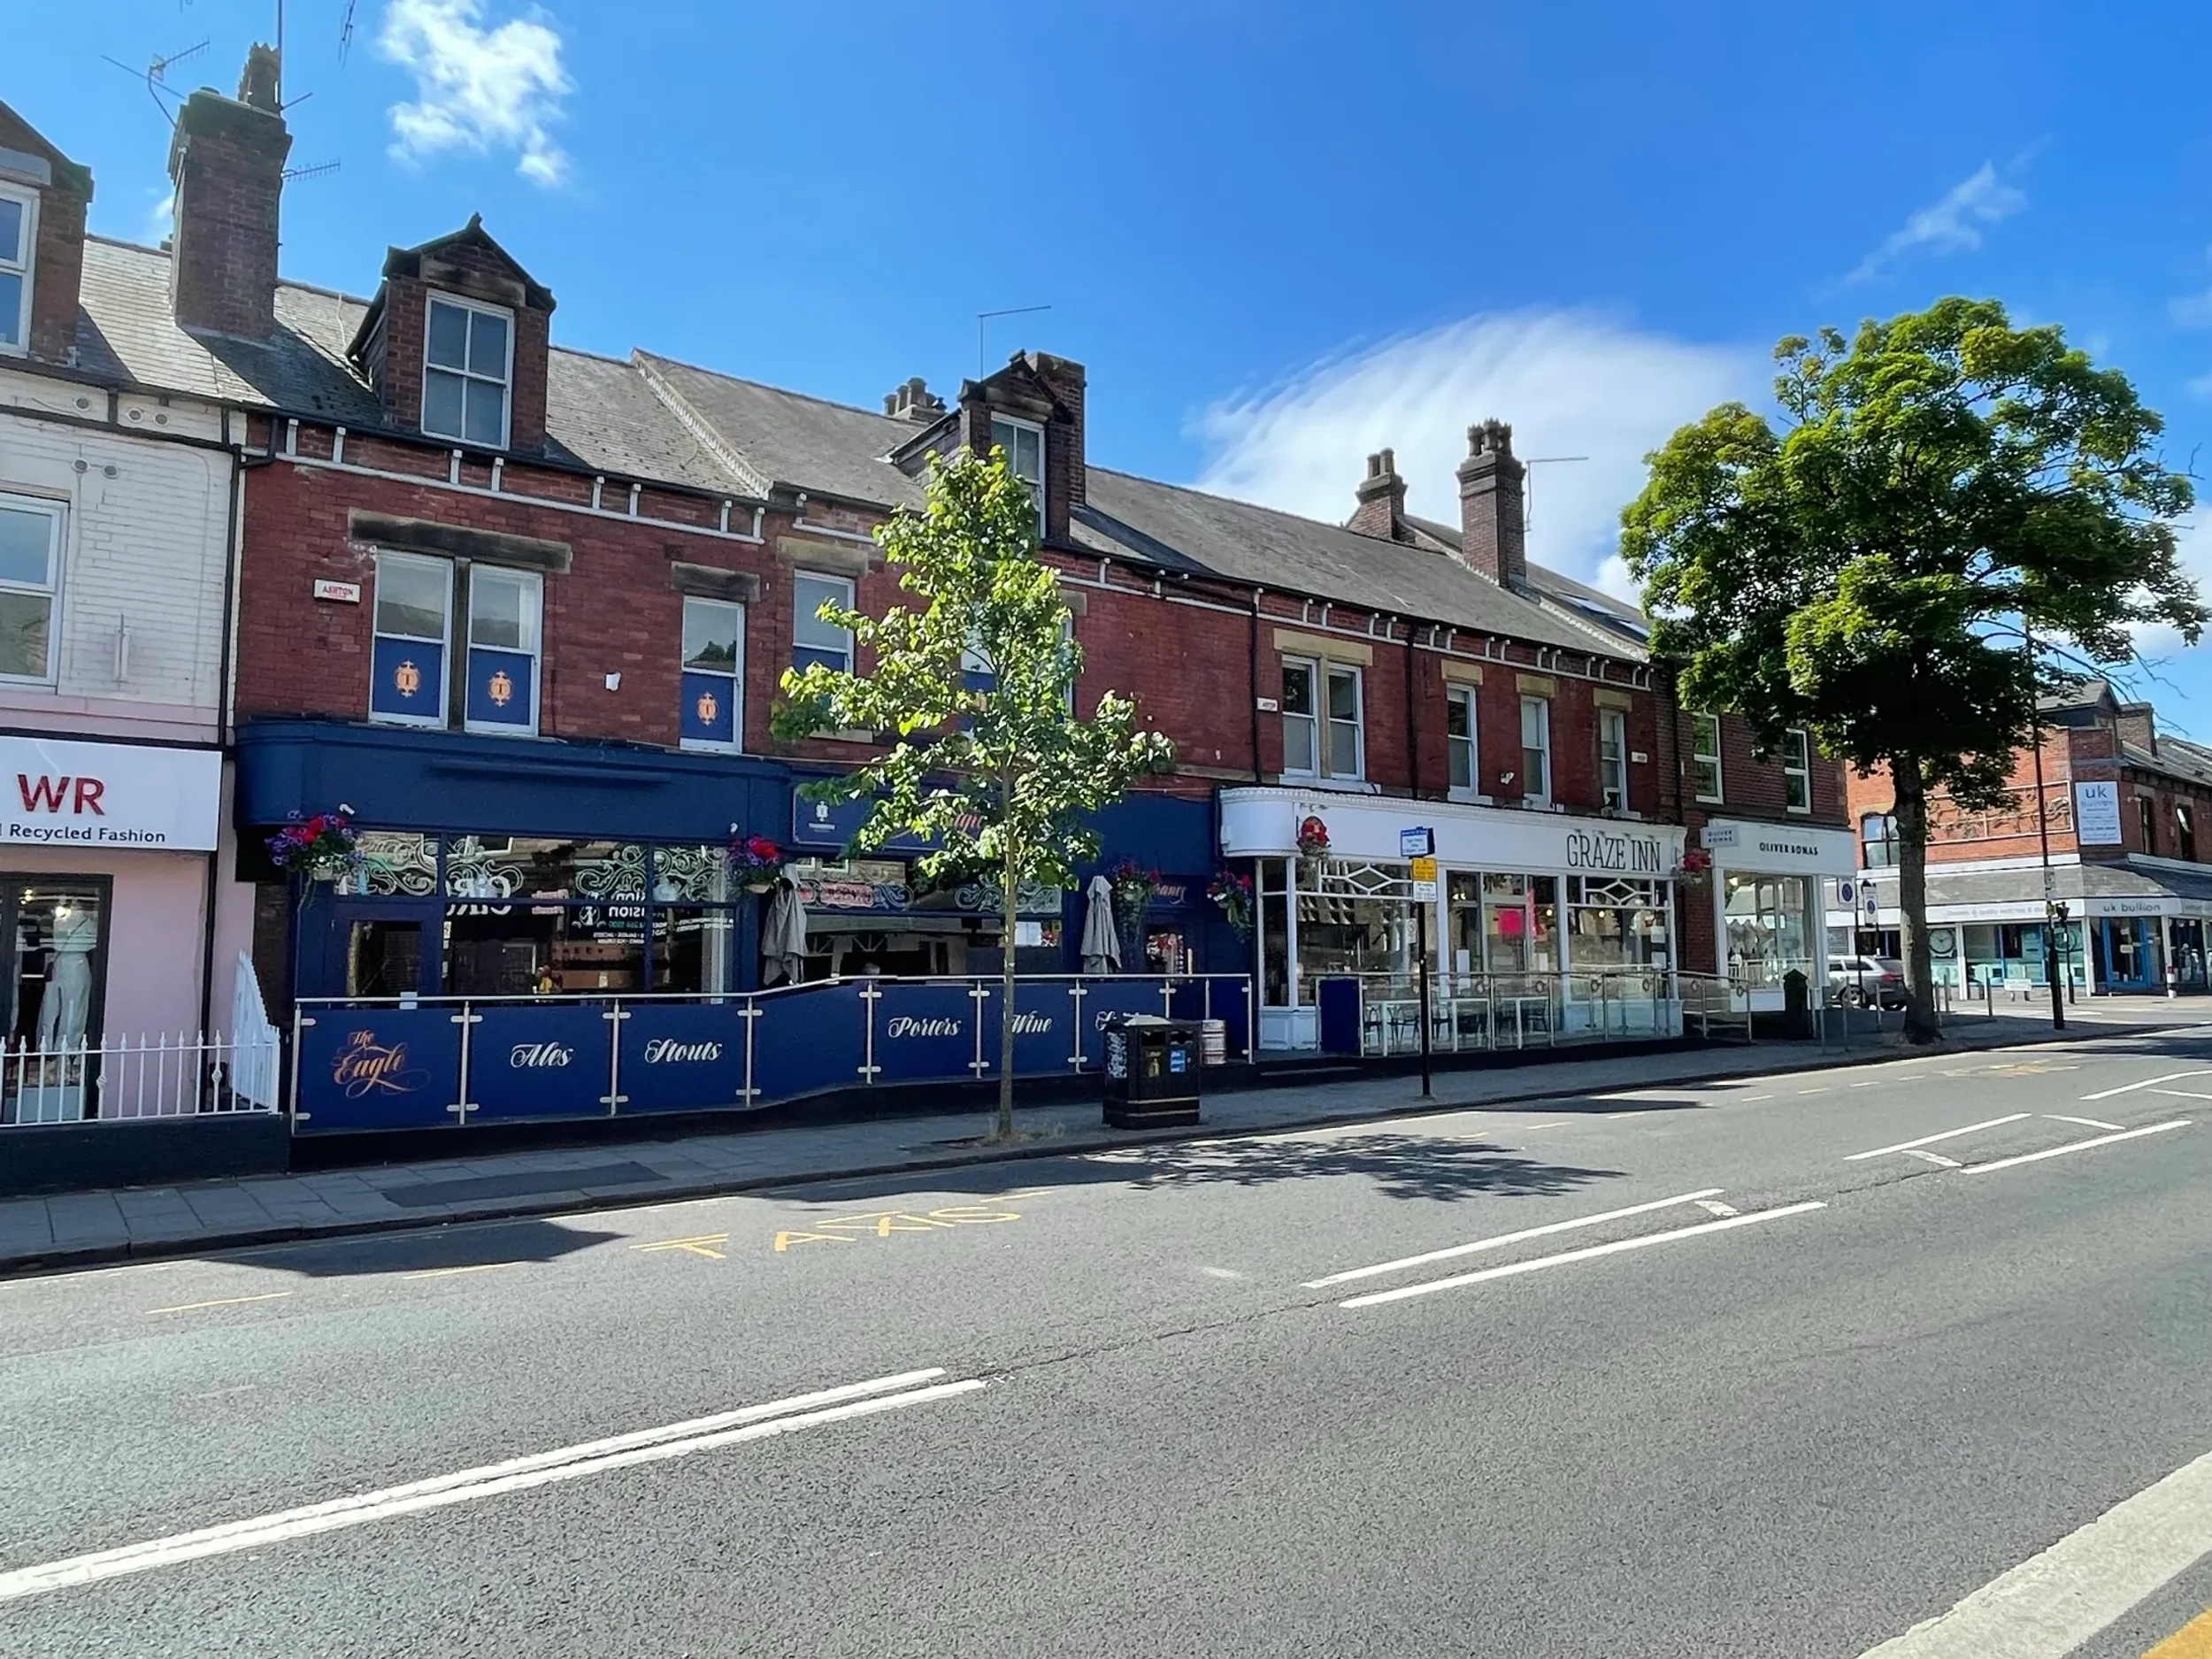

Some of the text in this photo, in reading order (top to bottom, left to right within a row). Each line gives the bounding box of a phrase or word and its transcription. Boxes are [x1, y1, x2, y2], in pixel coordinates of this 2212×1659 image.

[17, 773, 105, 816] WR
[2085, 785, 2108, 798] uk
[10, 824, 92, 841] Recycled
[99, 827, 166, 842] Fashion
[1567, 834, 1661, 872] GRAZE INN
[1759, 841, 1818, 856] OLIVER BONAS
[2103, 902, 2161, 912] uk bullion
[887, 1016, 962, 1039] Porters
[1003, 1010, 1053, 1035] Wine
[348, 1029, 376, 1048] The
[511, 1041, 573, 1068] Ales
[644, 1038, 723, 1064] Stouts
[330, 1042, 431, 1098] Eagle
